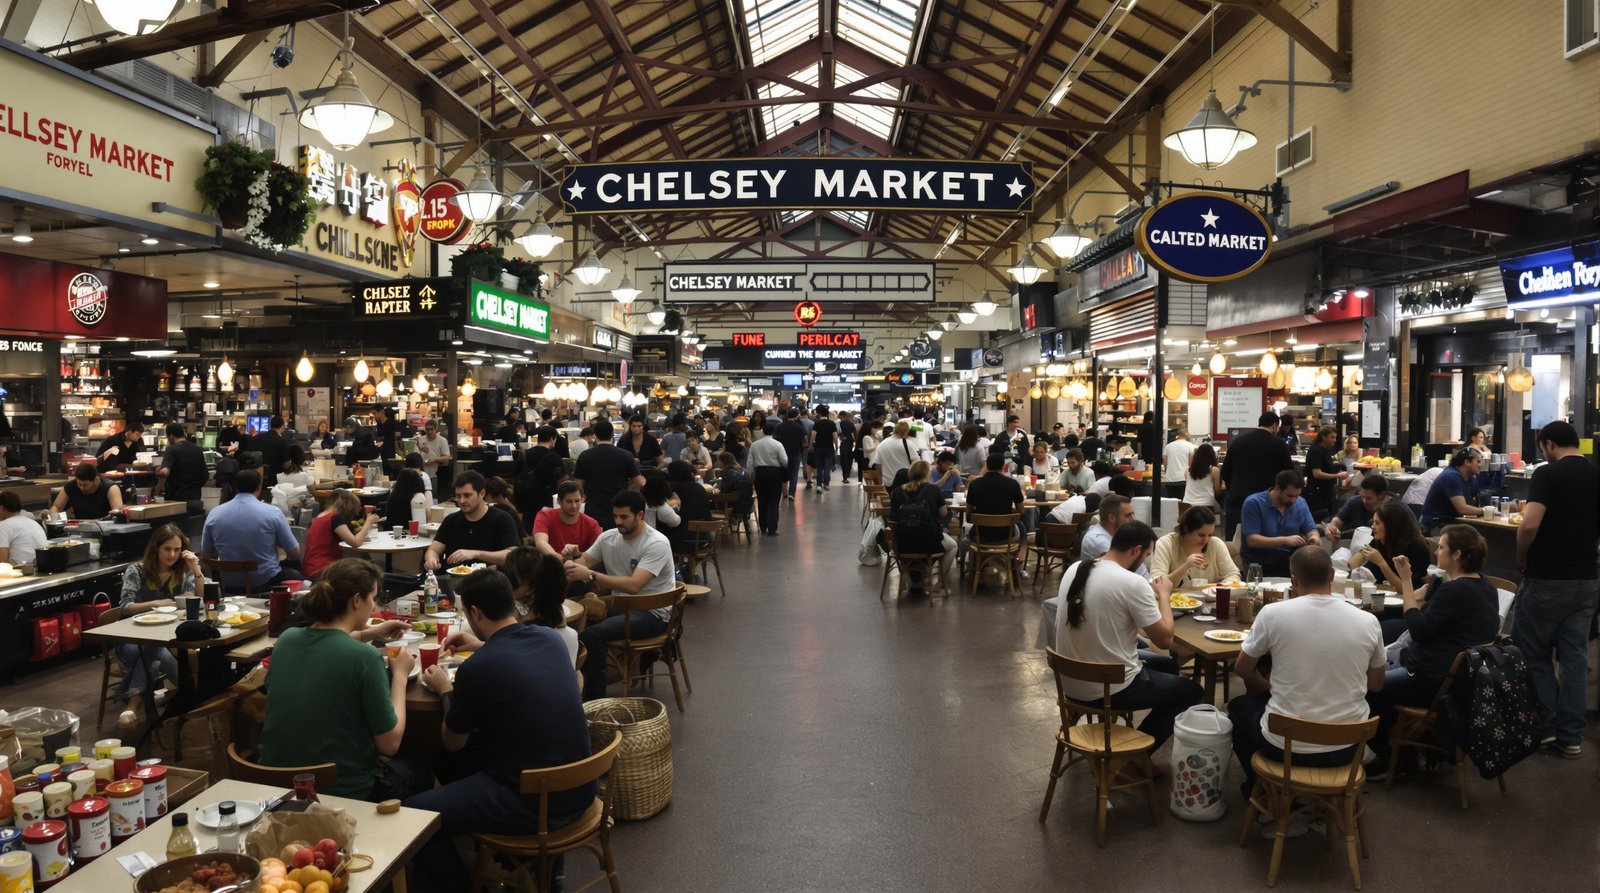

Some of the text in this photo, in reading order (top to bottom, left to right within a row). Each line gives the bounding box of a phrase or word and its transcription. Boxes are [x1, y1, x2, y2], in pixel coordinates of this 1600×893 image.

[47, 152, 93, 177] FORYEL
[90, 133, 174, 182] MARKET
[596, 169, 994, 203] CHELSEY MARKET
[1150, 229, 1266, 250] CALTED MARKET
[669, 275, 793, 289] CHELSEY MARKET
[12, 341, 43, 351] FONCE
[733, 334, 859, 346] FUNE PERILCAT
